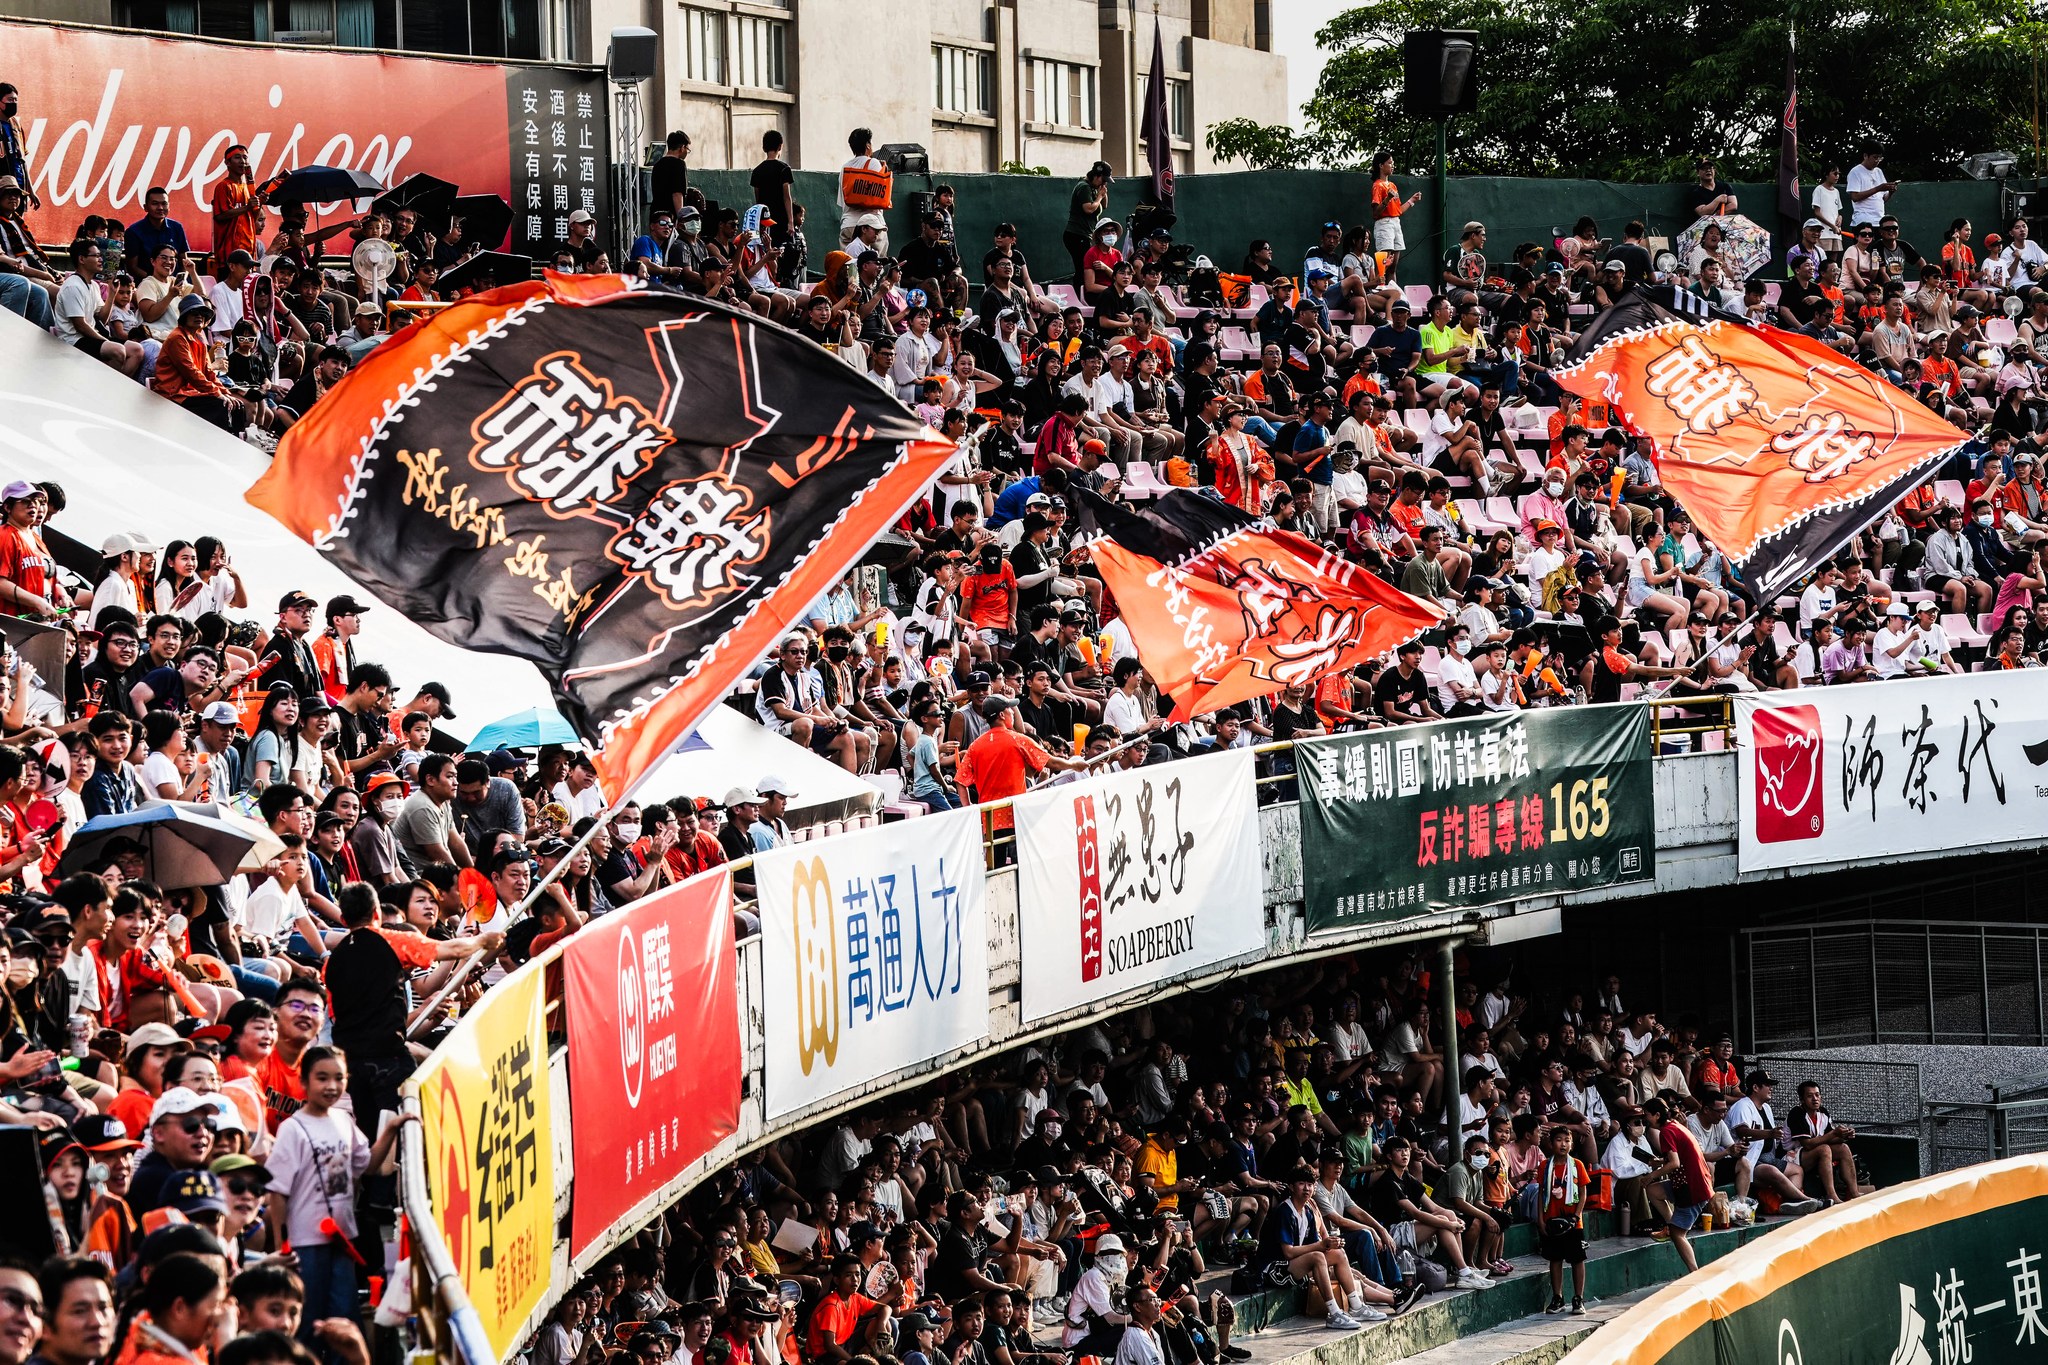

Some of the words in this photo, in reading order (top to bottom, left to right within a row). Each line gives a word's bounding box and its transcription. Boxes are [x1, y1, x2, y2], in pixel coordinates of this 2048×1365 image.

[522, 88, 543, 242] 安全有保障
[549, 89, 570, 242] 酒後不開車
[577, 92, 596, 214] 禁止酒駕
[1317, 738, 1421, 807] 事緩則圓
[1431, 722, 1531, 792] 防詐有法
[1417, 793, 1546, 868] 反詐騙專線
[1549, 775, 1611, 844] 165
[842, 857, 962, 1029] 萬通人力
[1108, 915, 1195, 976] SOAPBERRY
